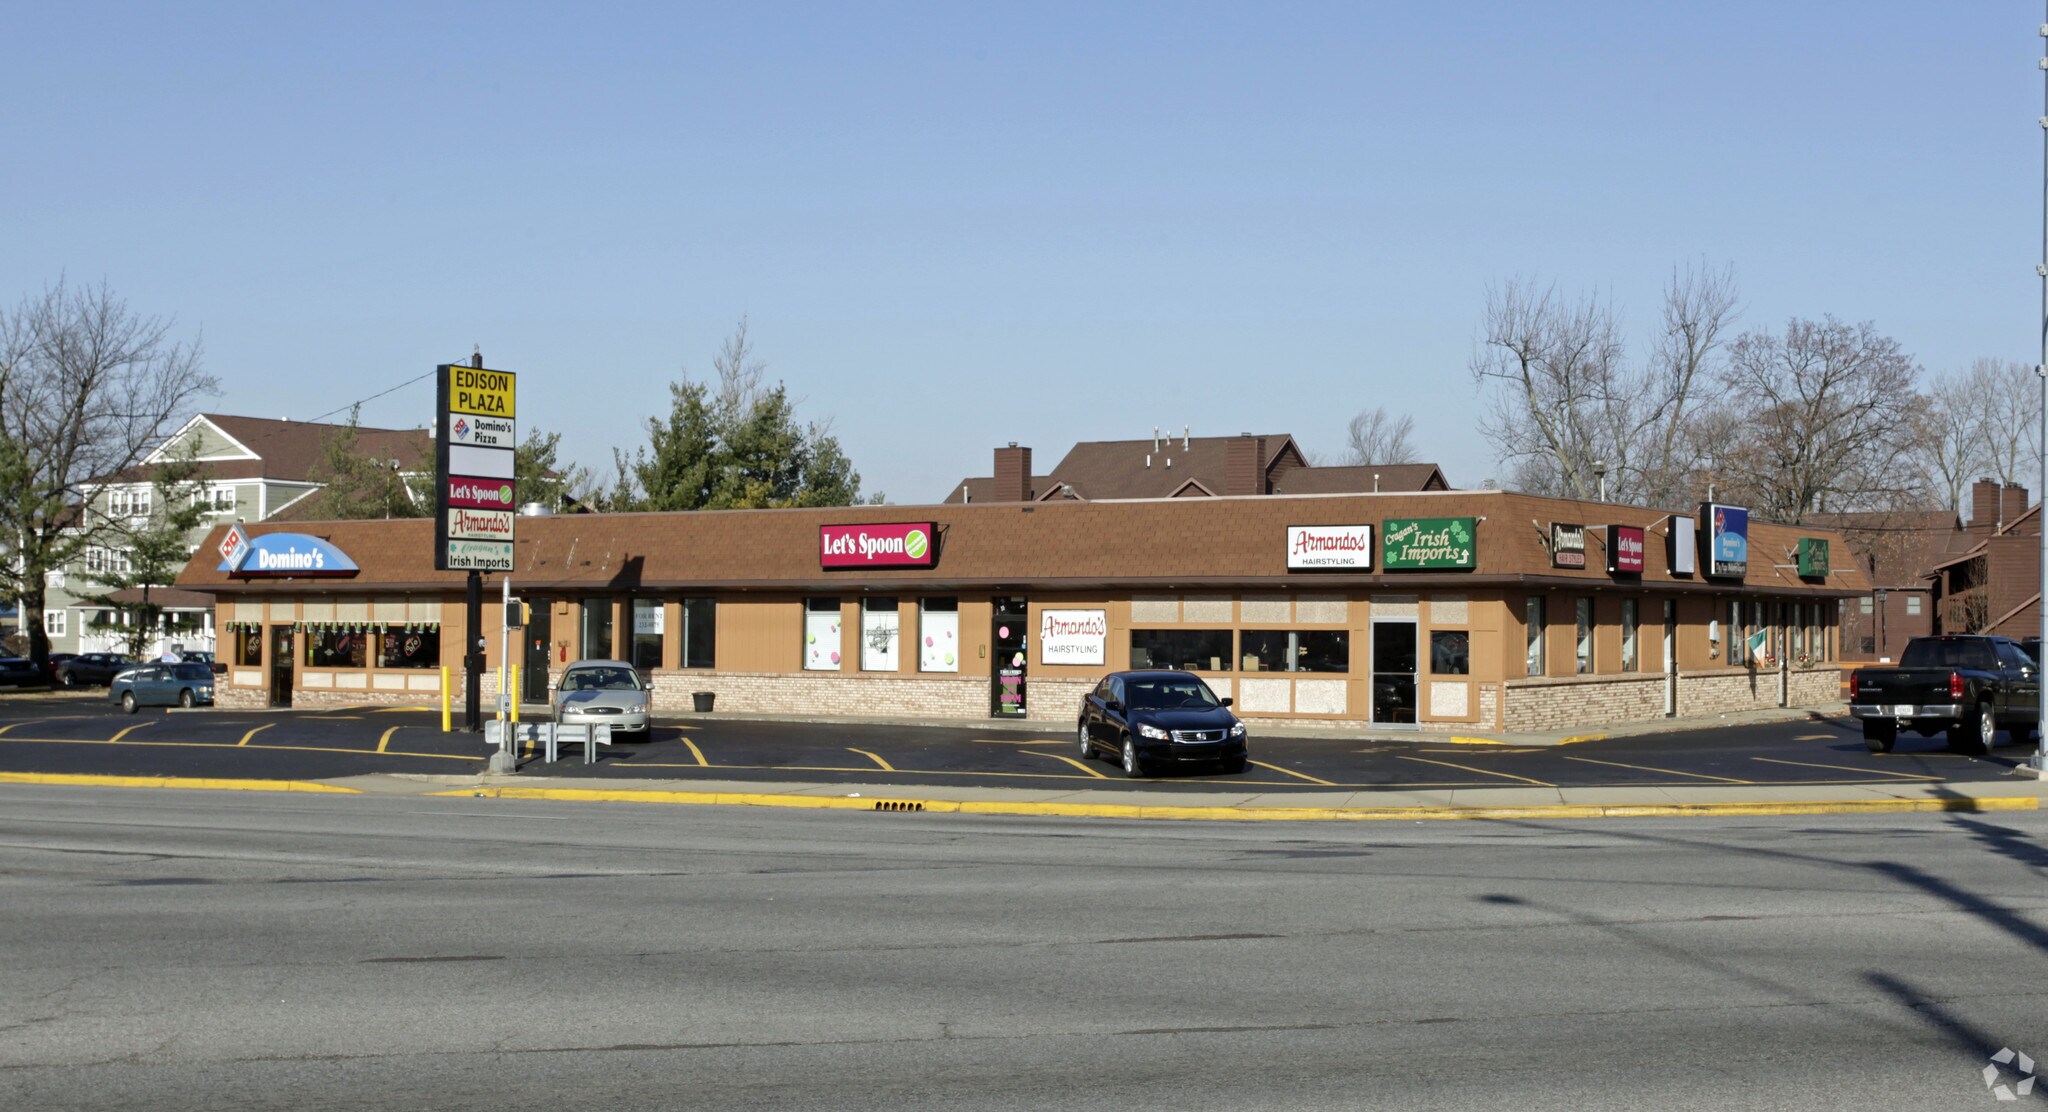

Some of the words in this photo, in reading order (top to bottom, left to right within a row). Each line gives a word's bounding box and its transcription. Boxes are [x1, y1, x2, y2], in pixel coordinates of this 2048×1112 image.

[456, 371, 508, 392] EDISON
[459, 391, 505, 413] PLAZA
[475, 419, 511, 433] Domino's
[474, 432, 497, 444] Pizza
[450, 483, 471, 499] Let's
[472, 485, 499, 504] Spoon
[451, 509, 510, 536] Armando's
[1293, 530, 1365, 556] Armandos
[1385, 522, 1419, 546] Cragan's
[1412, 528, 1450, 547] Irish
[824, 533, 856, 555] Let's
[858, 532, 904, 560] Spoon
[1400, 544, 1460, 566] Imports
[1618, 536, 1629, 551] Let's
[1629, 537, 1643, 556] Spoon
[258, 546, 324, 569] Domino's
[450, 555, 471, 567] Irish
[474, 556, 510, 570] Imports
[1041, 615, 1105, 640] Armando's
[1048, 645, 1098, 654] HAIRSTYLING
